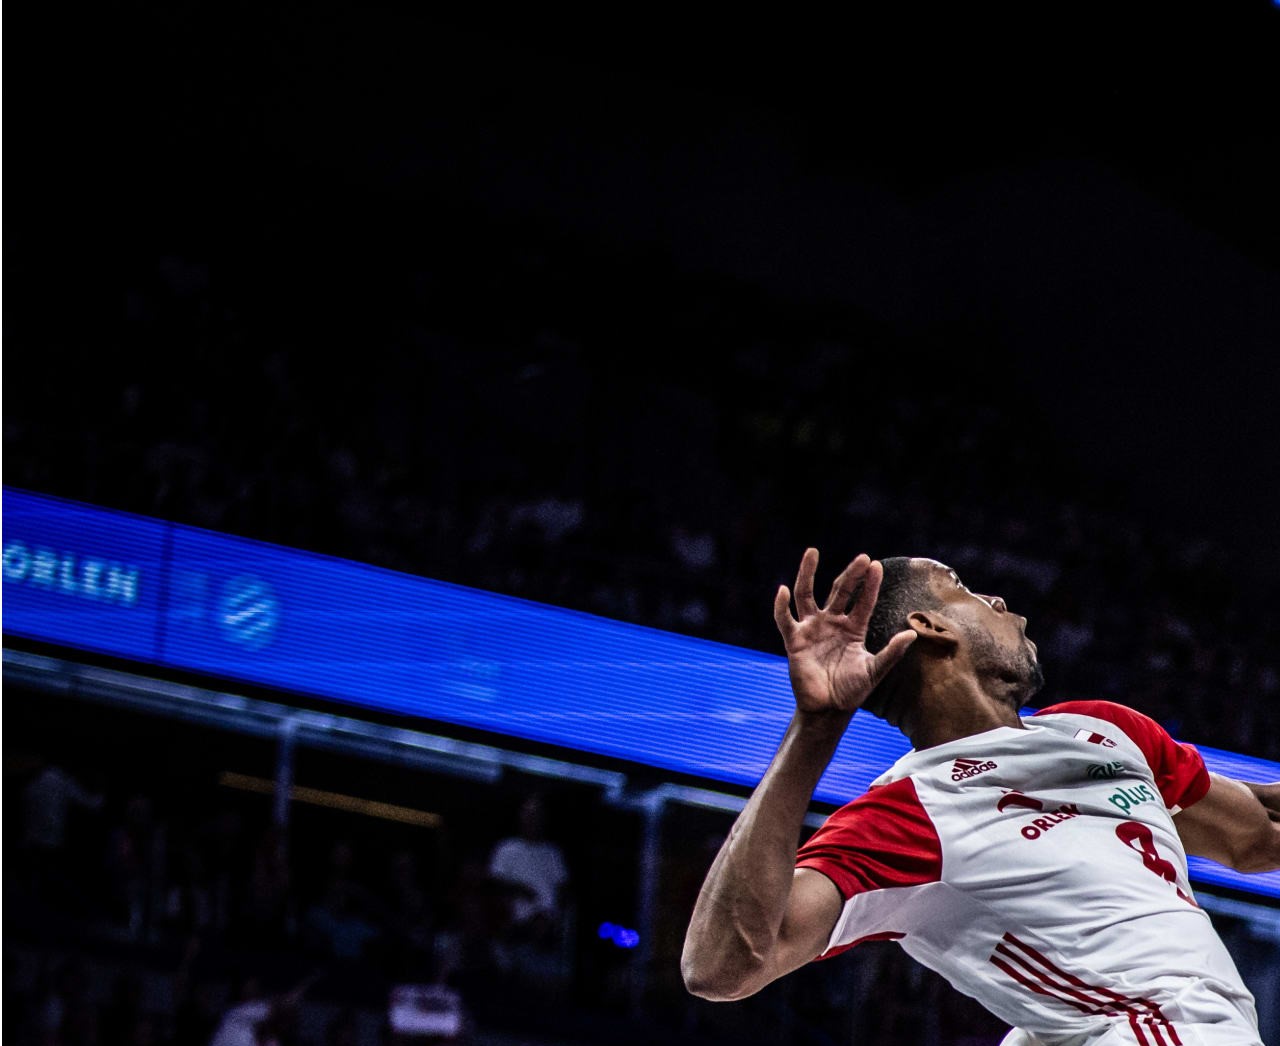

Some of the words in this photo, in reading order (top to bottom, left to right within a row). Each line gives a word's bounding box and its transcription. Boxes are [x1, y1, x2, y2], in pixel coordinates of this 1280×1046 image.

[951, 760, 998, 782] adidas
[1108, 784, 1155, 816] plus
[1020, 803, 1082, 840] ORLEN
